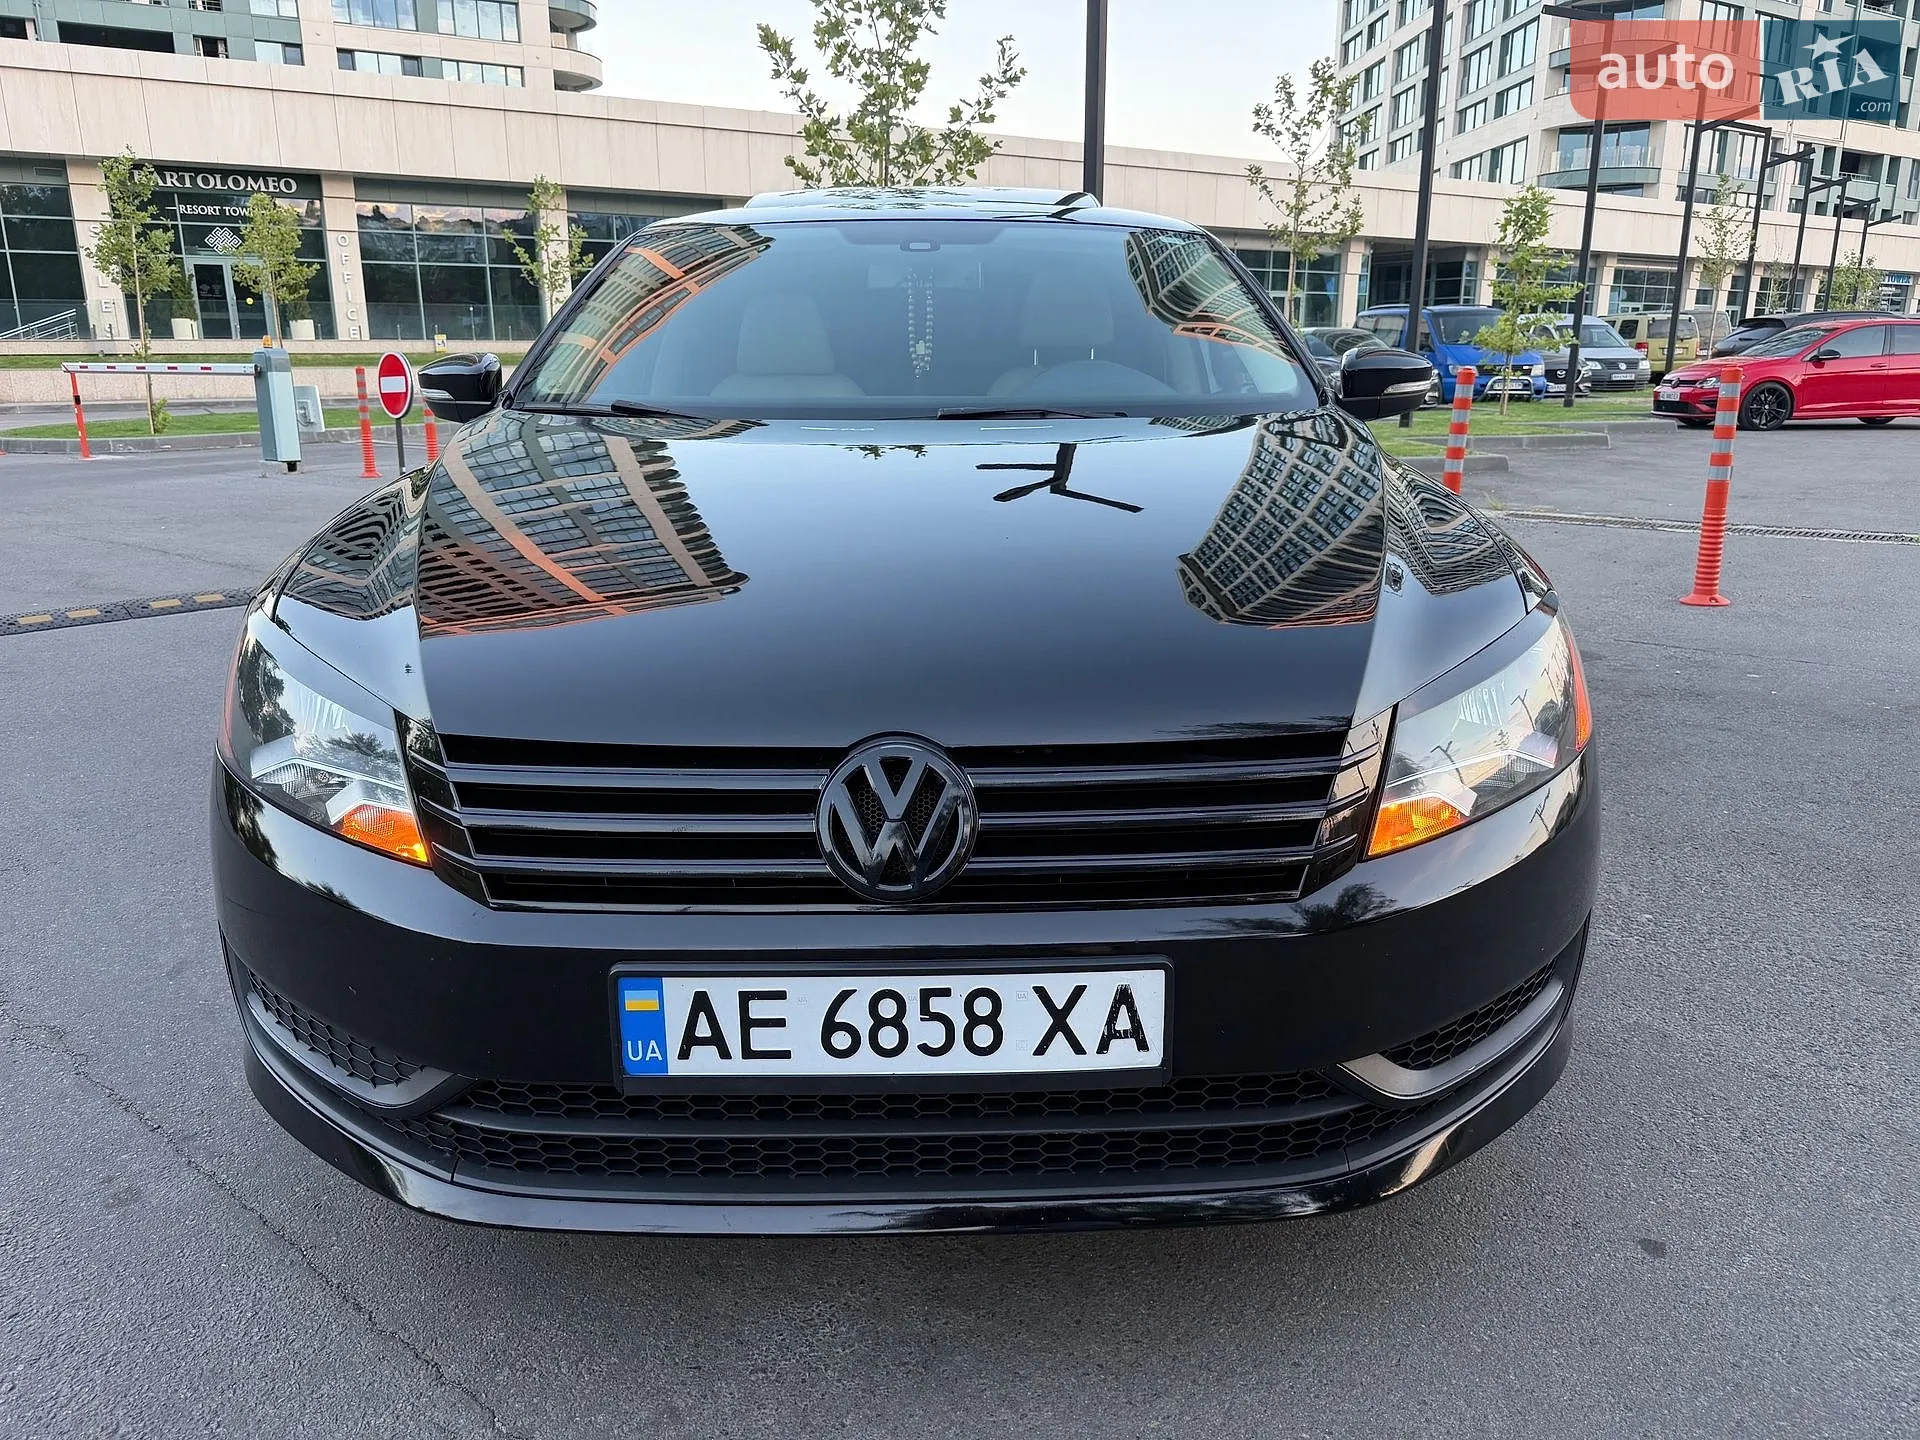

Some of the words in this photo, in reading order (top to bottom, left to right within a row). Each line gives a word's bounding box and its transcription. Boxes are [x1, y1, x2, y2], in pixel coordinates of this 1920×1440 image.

[179, 204, 221, 216] RESORT
[337, 234, 359, 338] OFFICE
[677, 990, 792, 1060] AE
[820, 987, 1004, 1060] 6858
[1032, 983, 1150, 1057] XA
[627, 1040, 663, 1062] UA
